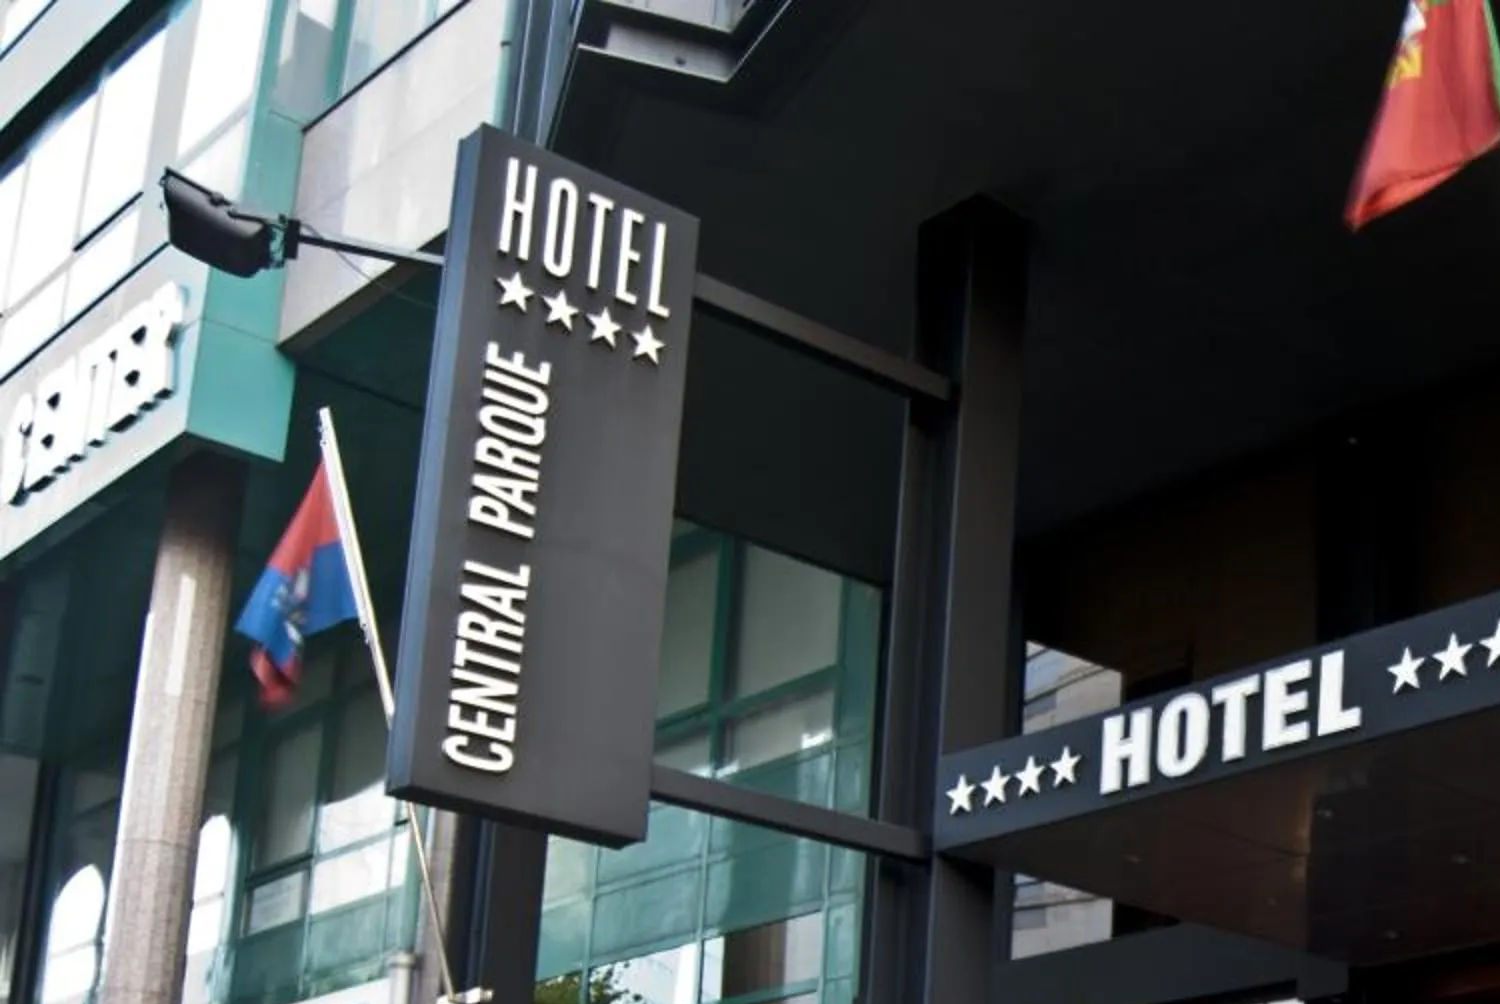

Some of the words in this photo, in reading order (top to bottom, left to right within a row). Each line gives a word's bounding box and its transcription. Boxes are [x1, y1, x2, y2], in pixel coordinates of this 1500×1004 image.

[498, 157, 671, 319] HOTEL
[467, 342, 552, 539] PARQUE
[441, 560, 531, 773] CENTRAL
[1100, 648, 1362, 794] HOTEL
